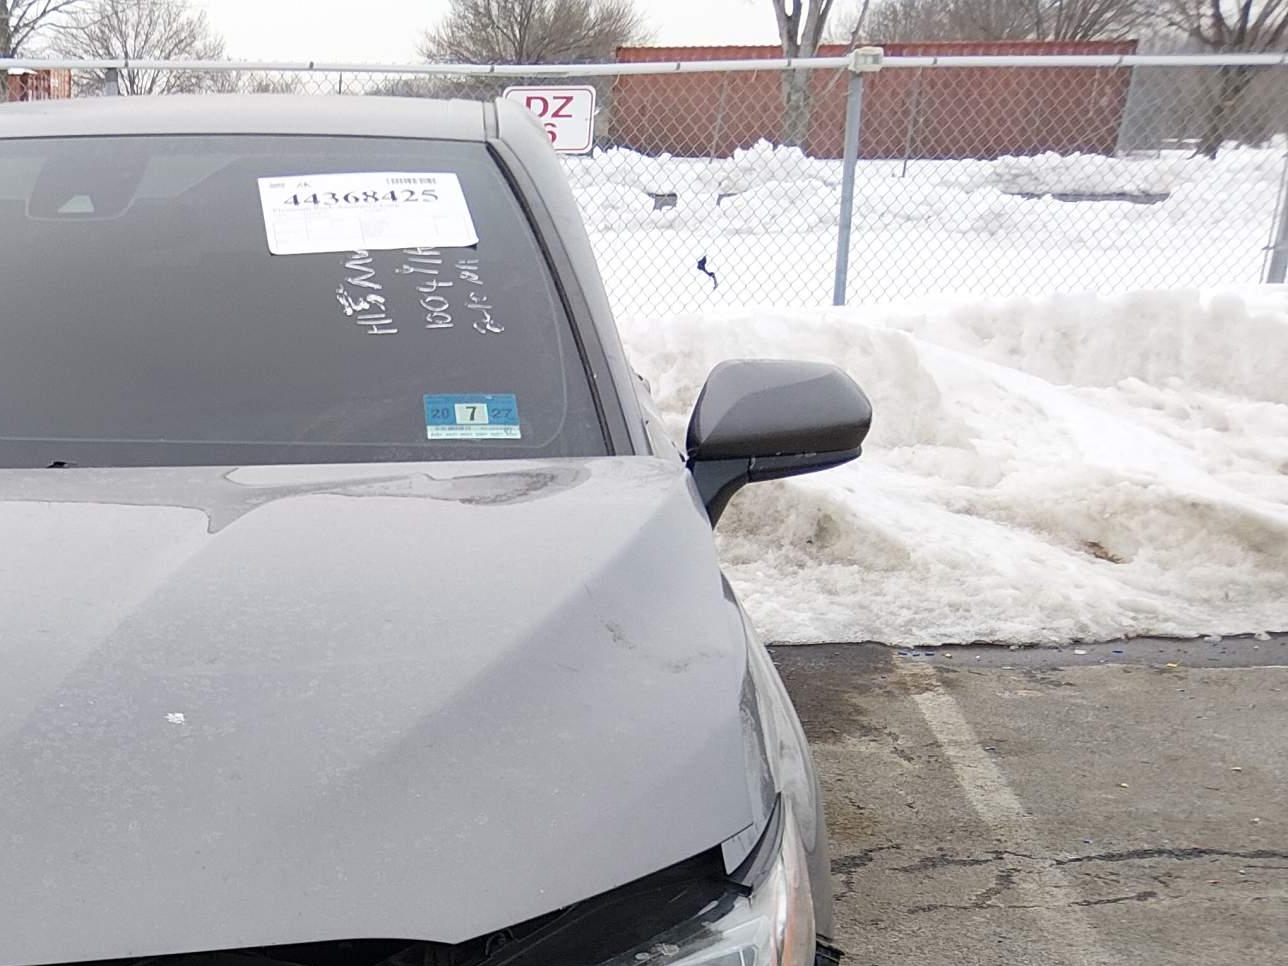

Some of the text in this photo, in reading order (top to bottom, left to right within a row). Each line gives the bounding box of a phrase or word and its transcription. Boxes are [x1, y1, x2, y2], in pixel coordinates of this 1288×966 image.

[525, 96, 573, 118] DZ
[283, 188, 439, 207] 44368425
[465, 406, 477, 421] 7
